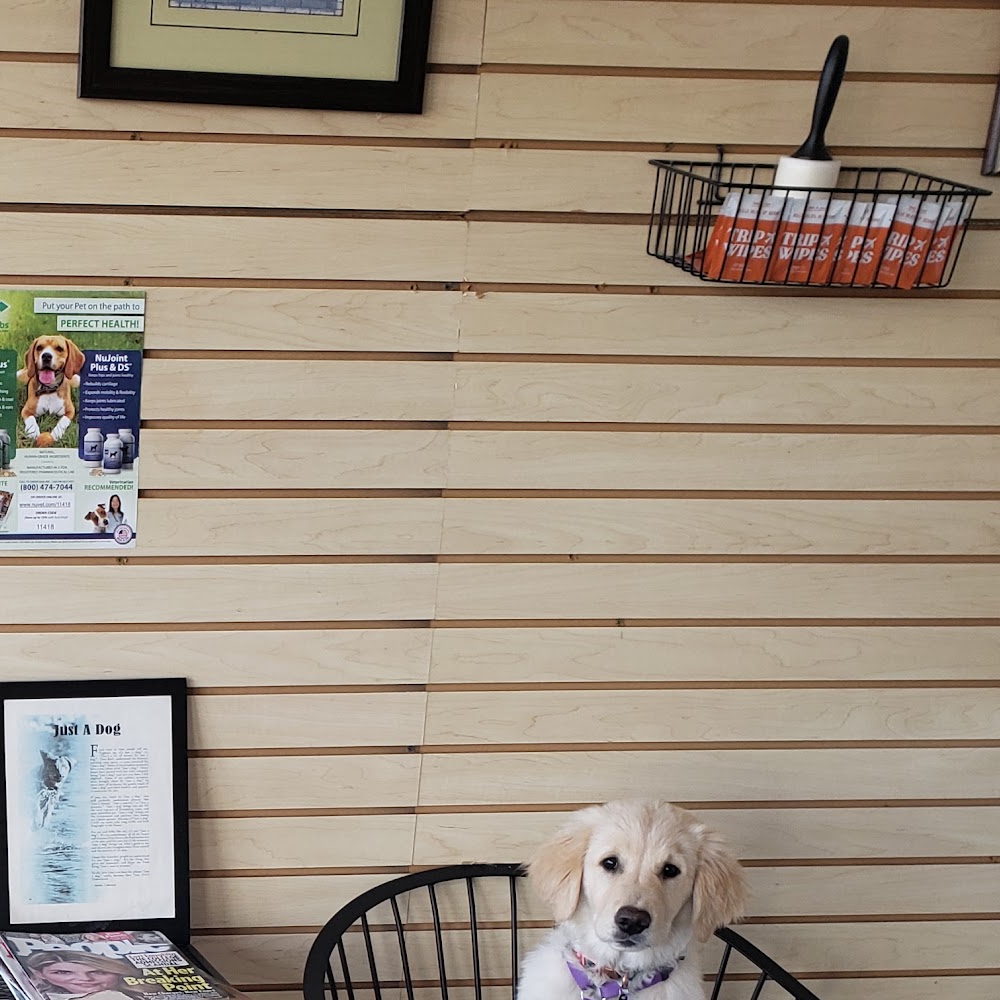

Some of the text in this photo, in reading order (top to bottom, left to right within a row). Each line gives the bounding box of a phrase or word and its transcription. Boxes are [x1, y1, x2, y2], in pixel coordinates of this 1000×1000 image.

[782, 231, 820, 246] TRIP
[42, 301, 55, 310] Put
[56, 303, 74, 312] your
[74, 302, 87, 310] Pet
[99, 302, 112, 311] the
[113, 302, 131, 312] path
[132, 303, 141, 311] to
[60, 319, 140, 329] PERFECT HEALTH!
[95, 353, 128, 363] NuJoint
[90, 363, 108, 372] Plus
[109, 363, 117, 372] &
[20, 483, 73, 492] (800) 474-7044
[53, 723, 121, 738] Just A Dog
[142, 966, 195, 977] At Her
[123, 975, 206, 987] Breaking
[162, 982, 213, 992] Point
